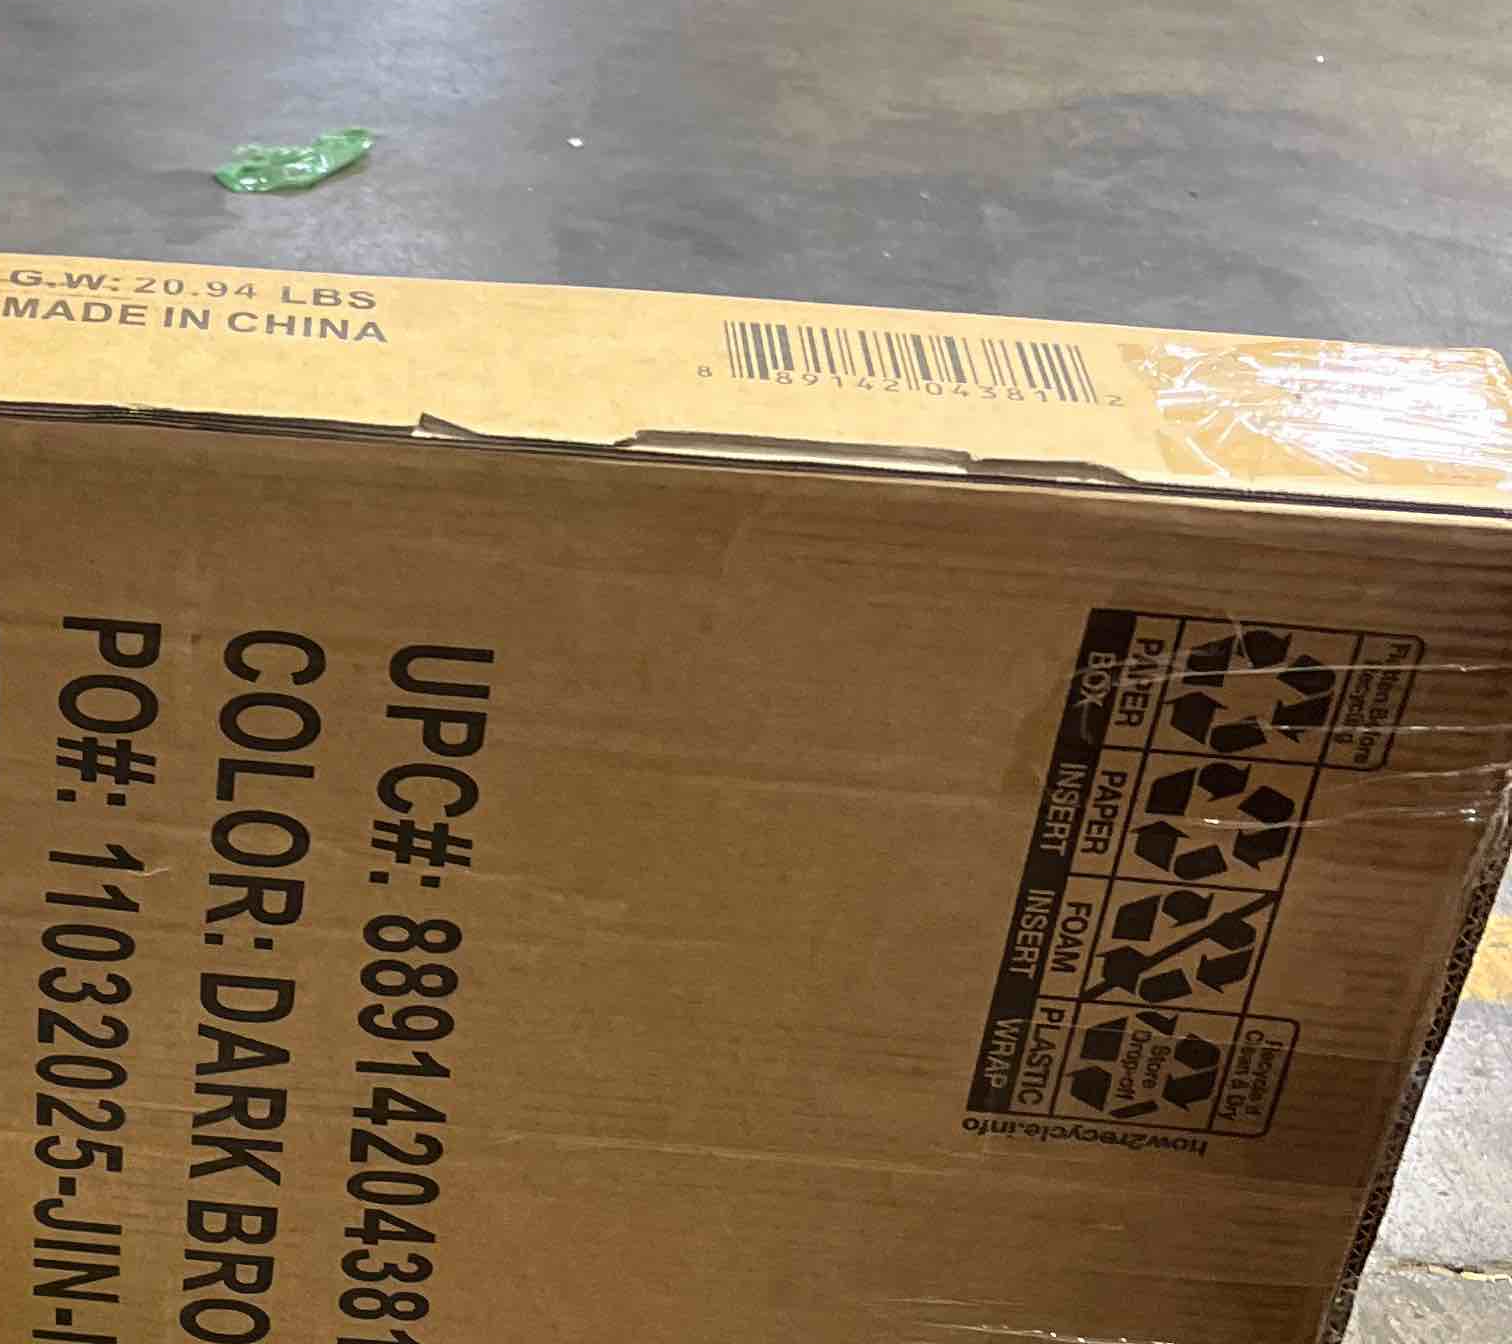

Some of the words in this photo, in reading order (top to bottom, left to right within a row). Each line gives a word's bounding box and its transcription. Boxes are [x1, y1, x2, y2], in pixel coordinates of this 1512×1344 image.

[1, 296, 148, 327] MADE
[163, 306, 210, 332] IN
[227, 311, 388, 343] CHINA
[9, 269, 121, 292] G.W:
[134, 277, 257, 301] 20.94
[281, 286, 377, 310] LBS
[697, 364, 713, 378] 8
[776, 370, 900, 393] 89142
[925, 382, 1050, 403] 04381
[1105, 394, 1126, 407] 2
[55, 615, 162, 807] PO#:
[1076, 651, 1116, 709] BOX
[1114, 637, 1166, 729] PAPER
[204, 630, 326, 951] COLOR:
[369, 644, 495, 889] UPC#:
[1039, 762, 1088, 857] INSERT
[1079, 769, 1129, 857] PAPER
[1007, 888, 1056, 980] INSERT
[1049, 901, 1094, 975] FOAM
[188, 972, 296, 1187] DARK
[982, 1017, 1027, 1090] WRAP
[1016, 1006, 1066, 1106] PLASTIC
[1142, 1044, 1172, 1090] Store
[961, 1115, 1209, 1157] how2recycle.info
